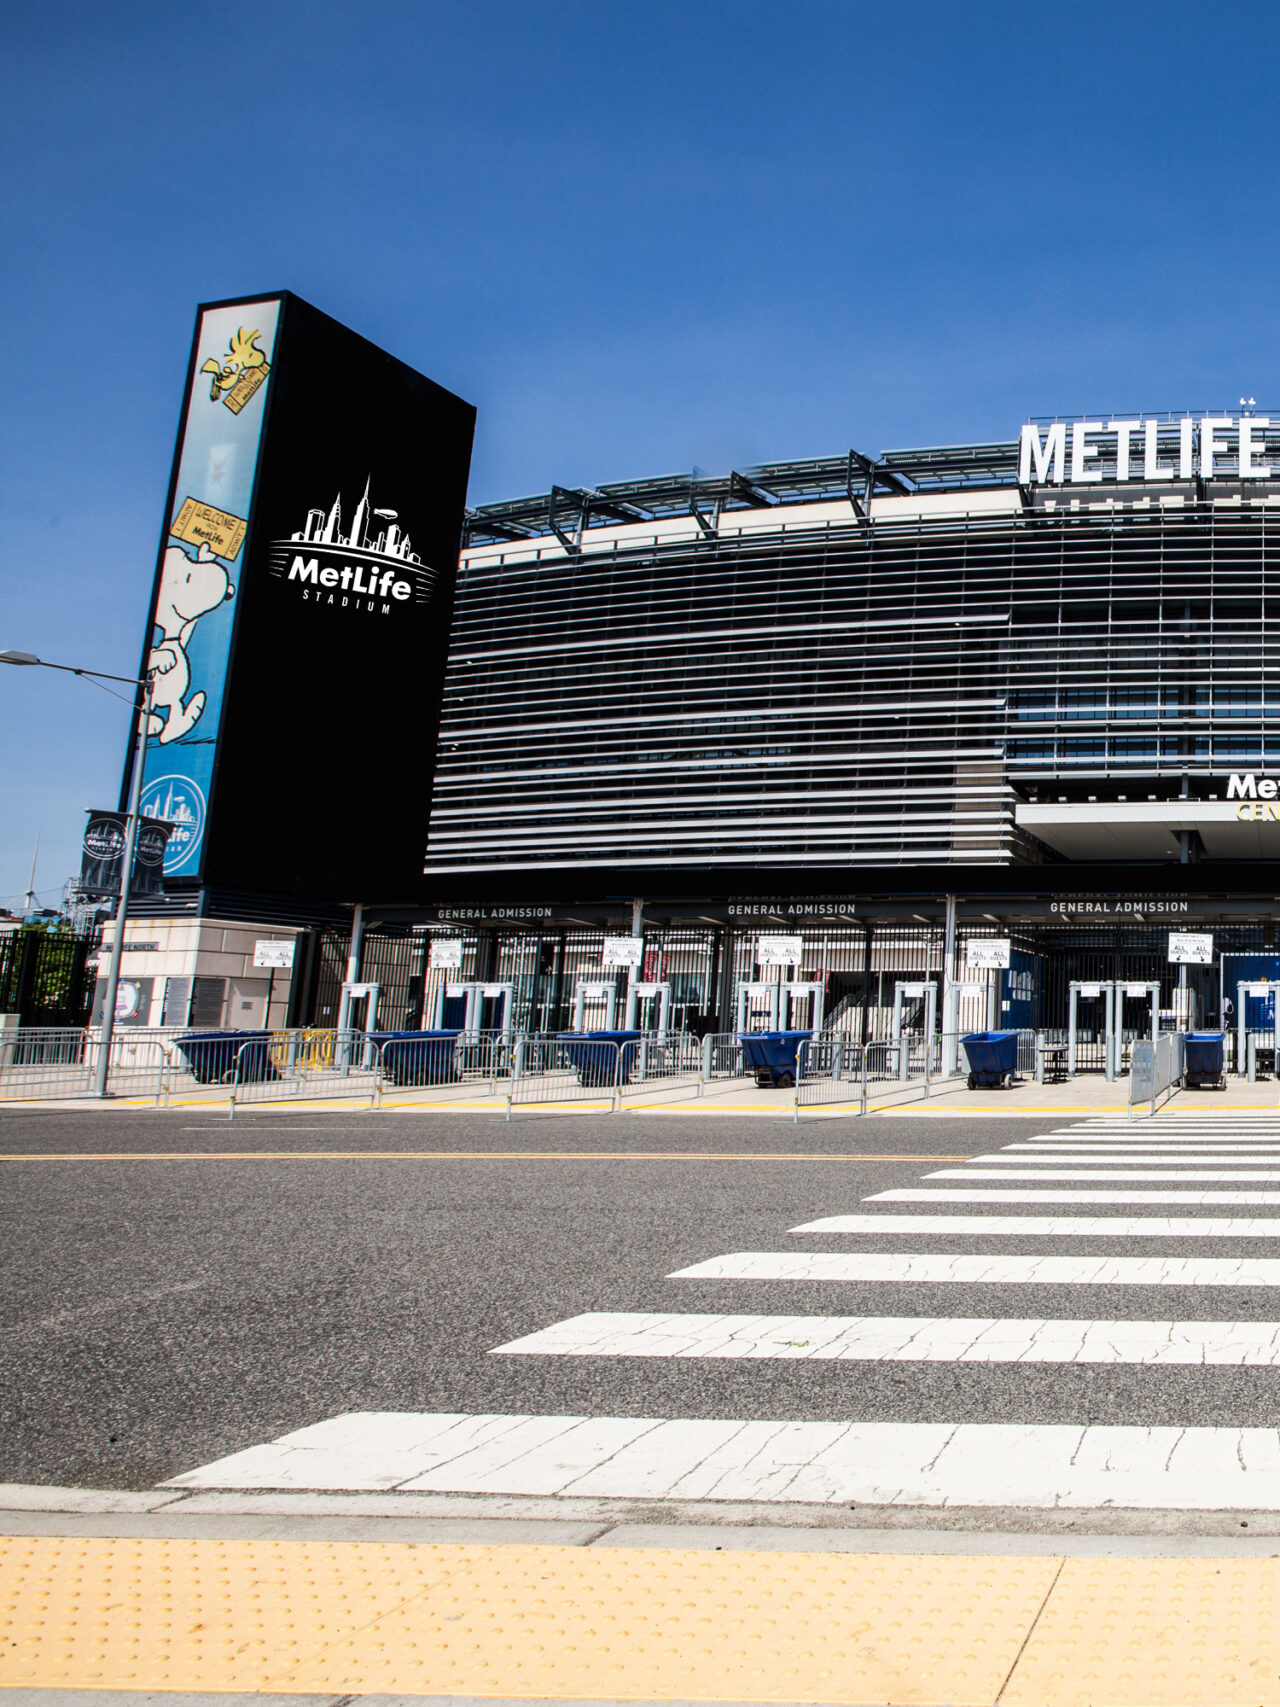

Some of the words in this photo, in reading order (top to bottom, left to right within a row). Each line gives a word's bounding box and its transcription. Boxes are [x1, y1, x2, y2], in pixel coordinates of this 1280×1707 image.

[1018, 416, 1271, 484] METLIFE
[195, 505, 237, 531] WELCOME
[192, 525, 224, 545] MetLife
[287, 555, 412, 600] MetLife
[302, 589, 390, 615] STADIUM
[437, 909, 487, 919] GENERAL
[491, 907, 552, 918] ADMISSION
[728, 905, 783, 915] GENERAL
[788, 904, 855, 914] ADMISSION
[1050, 902, 1110, 912] GENERAL
[1115, 902, 1188, 912] ADMISSION
